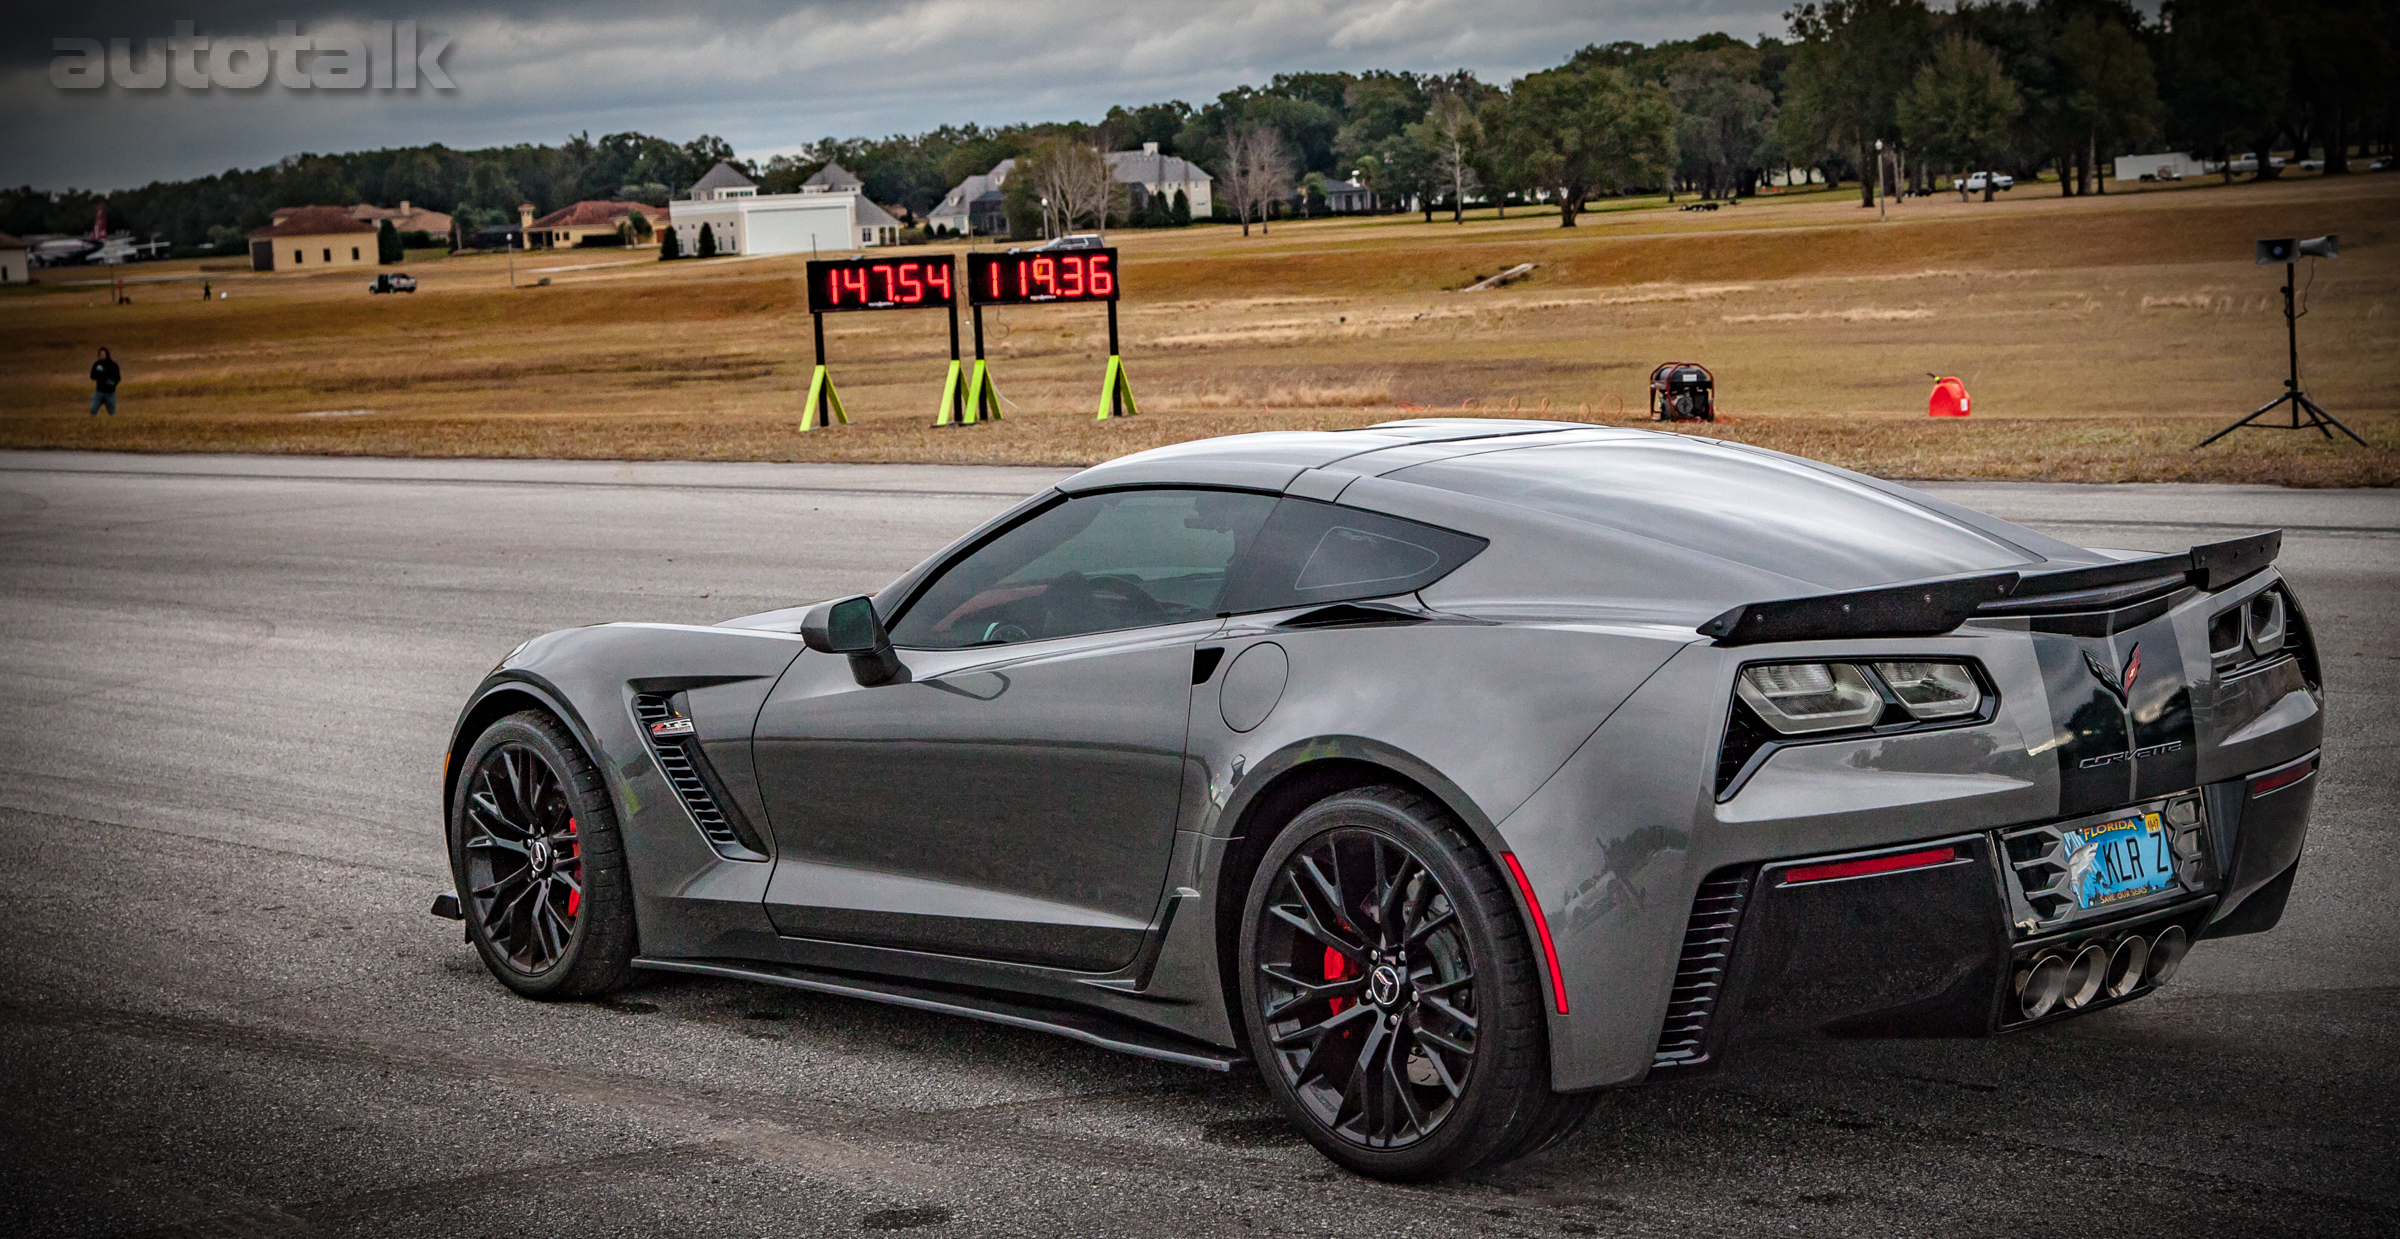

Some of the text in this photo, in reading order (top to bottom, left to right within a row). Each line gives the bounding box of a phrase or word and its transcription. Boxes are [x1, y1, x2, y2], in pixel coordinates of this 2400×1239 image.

[831, 263, 950, 304] 147.54
[991, 256, 1113, 298] 119.36
[650, 718, 694, 732] Z06
[2078, 740, 2182, 770] CORVETTE
[2083, 818, 2138, 841] FLORIDA
[2102, 831, 2169, 885] KLR Z
[2100, 885, 2148, 904] SAVE OUR SEAS
